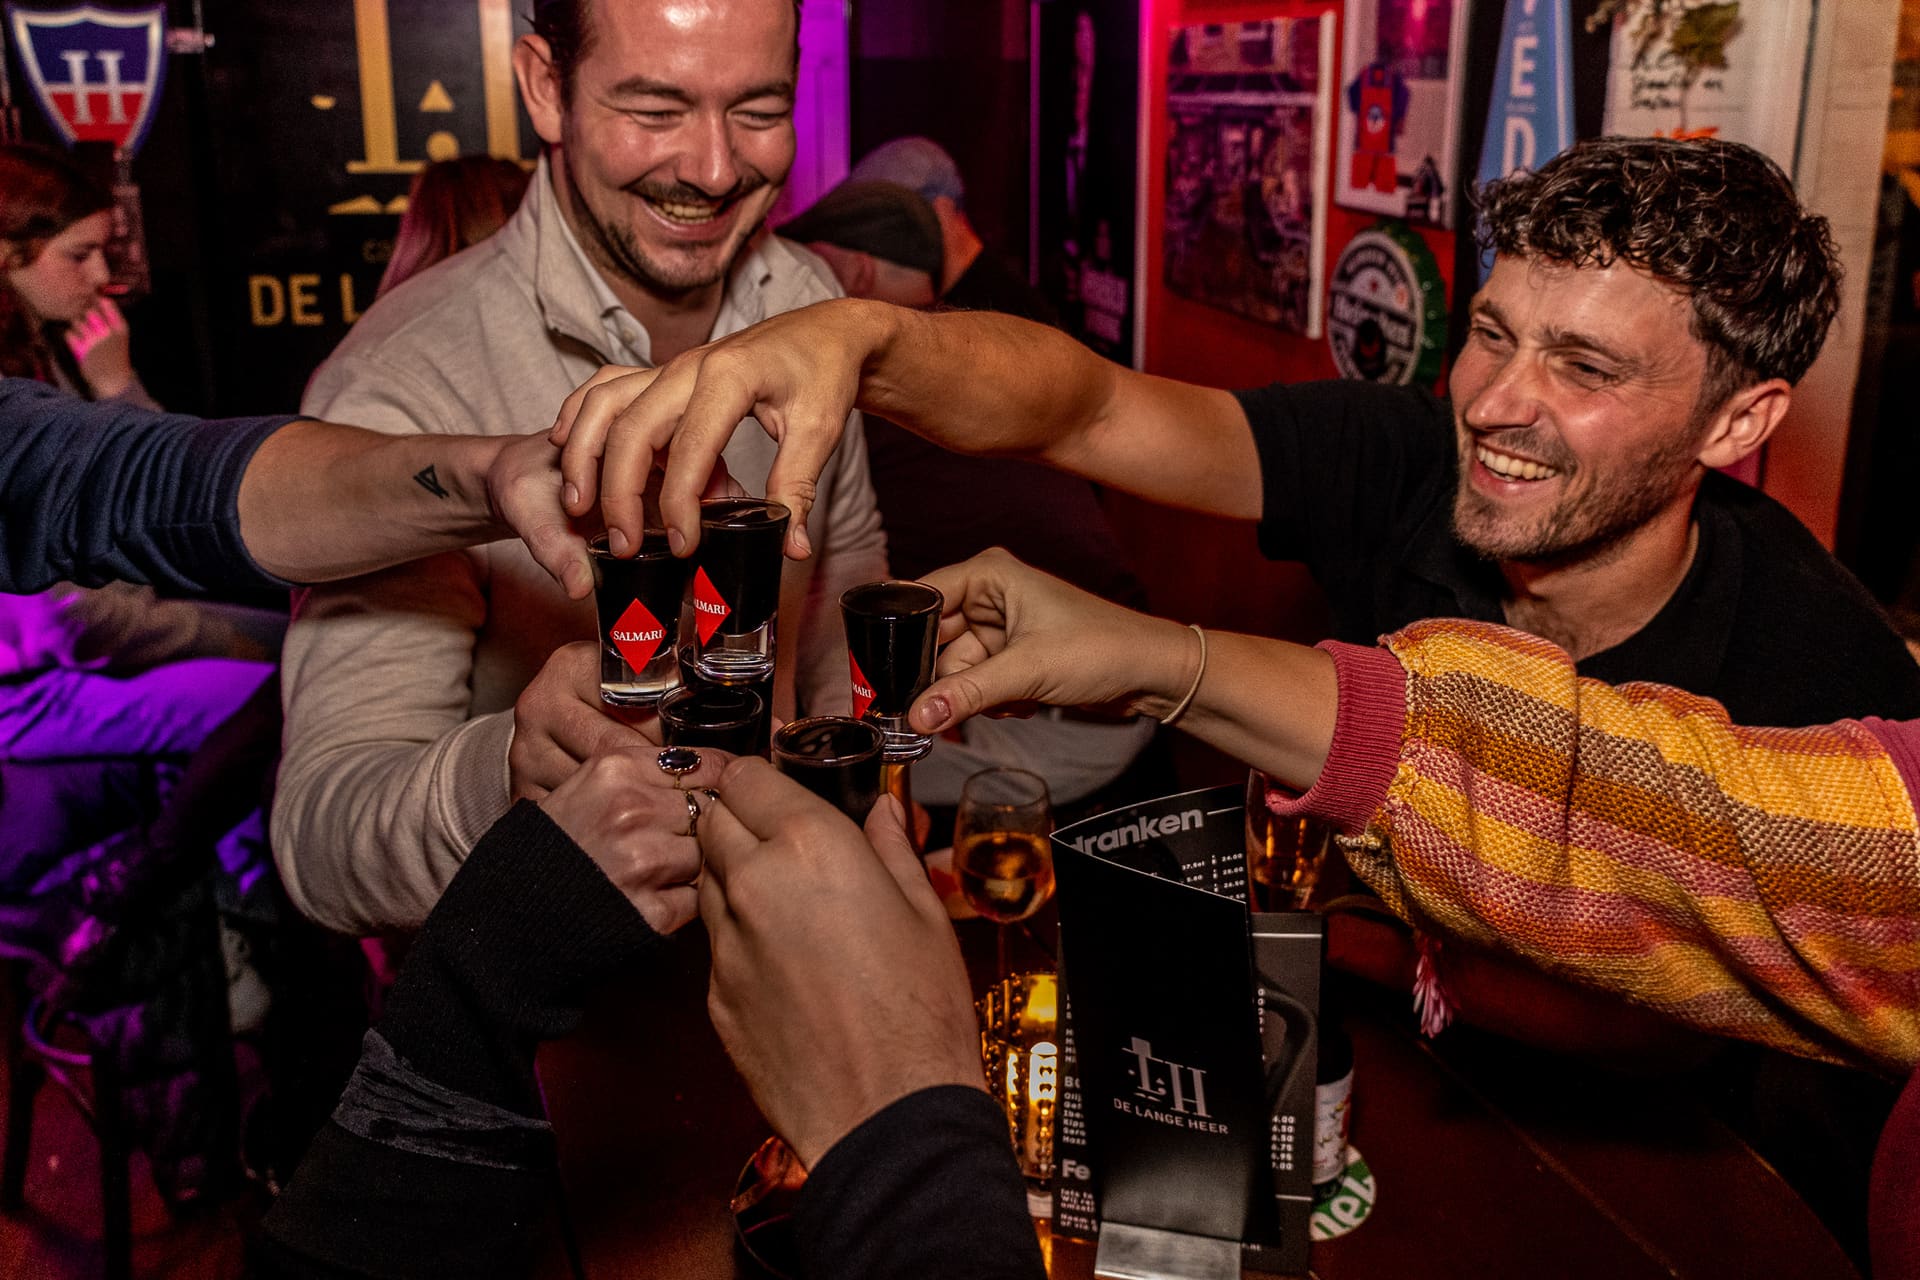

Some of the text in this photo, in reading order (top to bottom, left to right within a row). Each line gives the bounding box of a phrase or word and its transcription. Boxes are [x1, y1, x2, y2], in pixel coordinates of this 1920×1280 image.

[250, 273, 324, 326] DE
[613, 629, 663, 641] SALMARI
[1113, 1097, 1229, 1135] DE LANGE HEER
